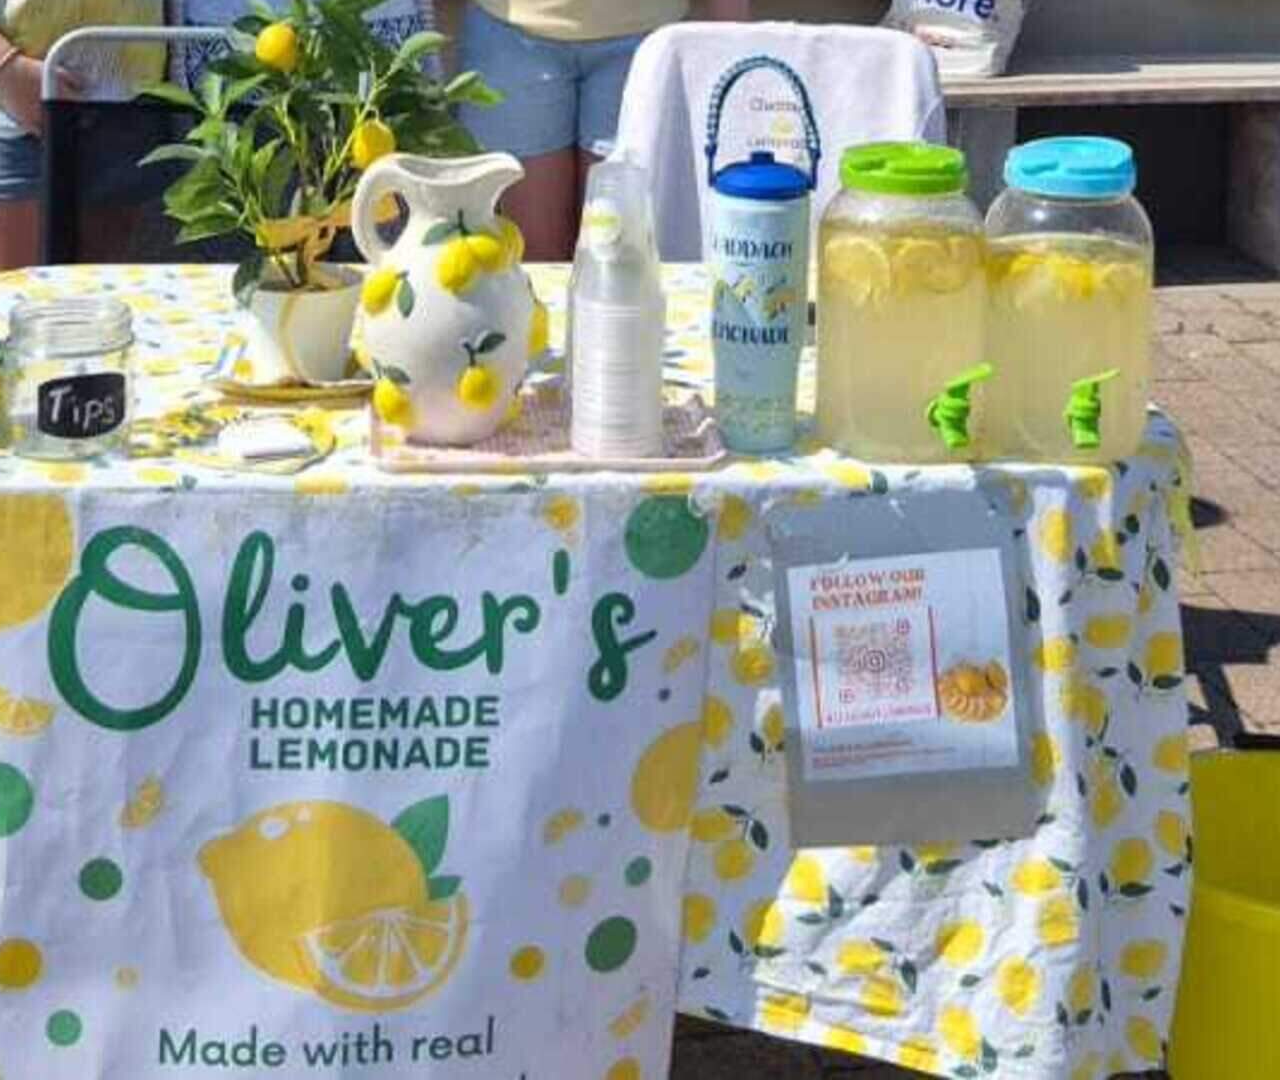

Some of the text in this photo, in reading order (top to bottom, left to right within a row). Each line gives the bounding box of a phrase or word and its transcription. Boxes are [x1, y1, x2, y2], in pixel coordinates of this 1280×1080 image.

[49, 383, 115, 431] Tips
[810, 567, 925, 590] FOLLOW OUR
[47, 525, 657, 731] Oliver's
[251, 696, 500, 729] HOMEMADE
[250, 736, 490, 770] LEMONADE
[158, 1015, 495, 1067] Made with real
